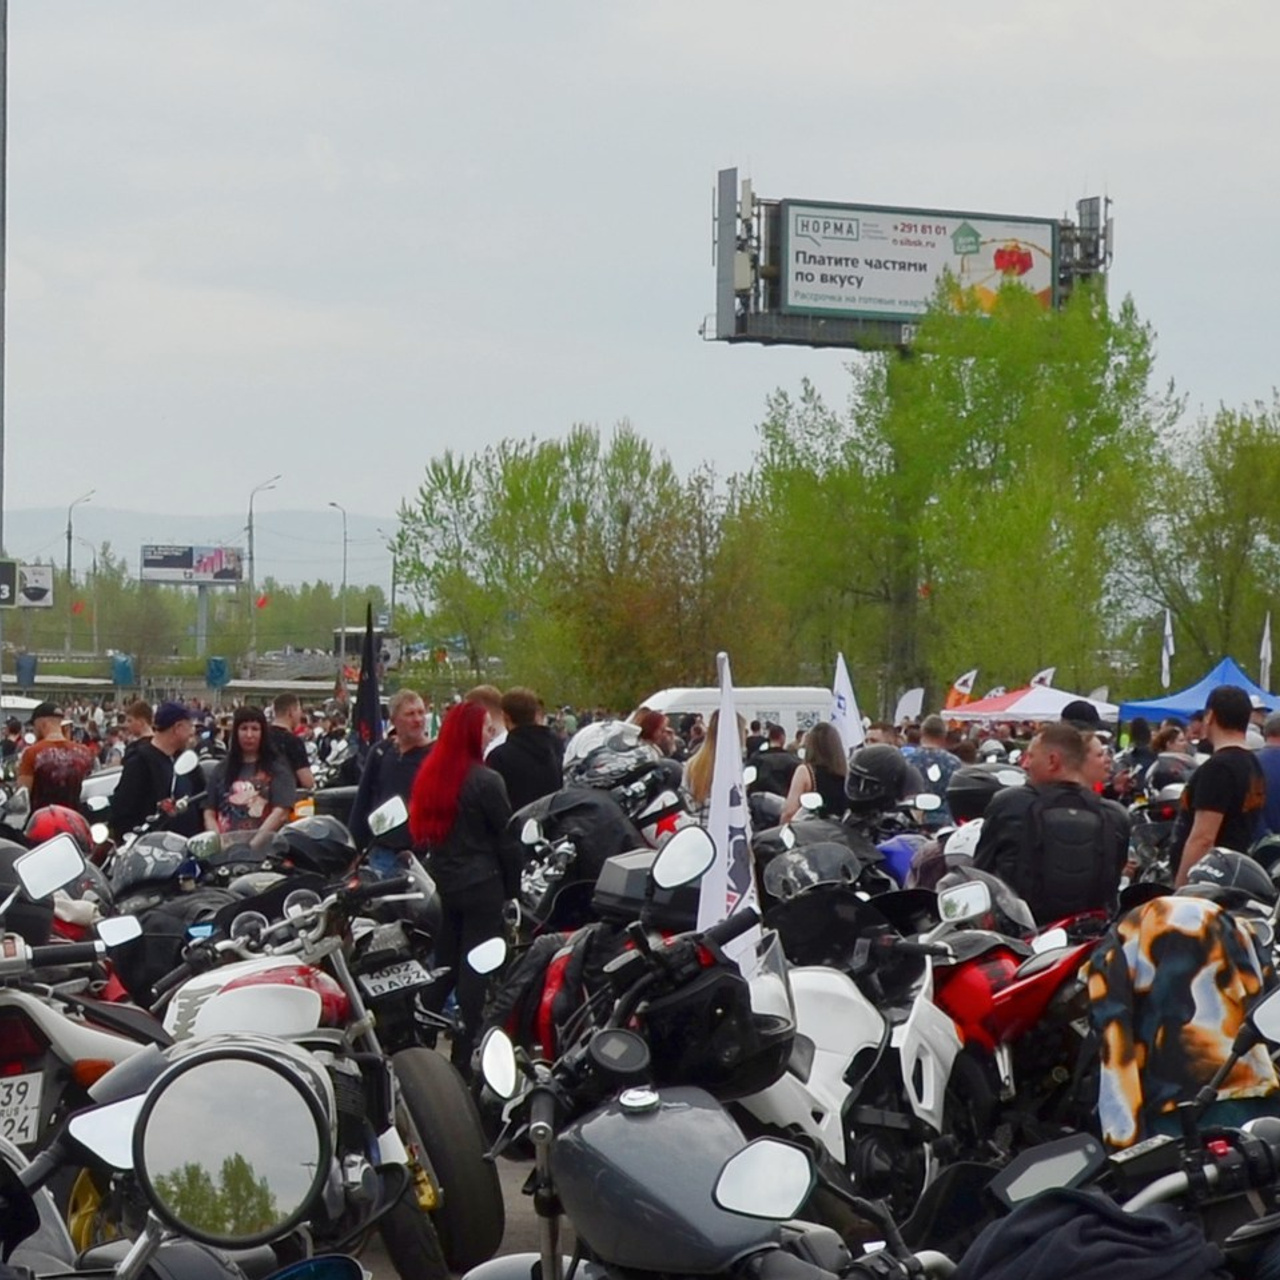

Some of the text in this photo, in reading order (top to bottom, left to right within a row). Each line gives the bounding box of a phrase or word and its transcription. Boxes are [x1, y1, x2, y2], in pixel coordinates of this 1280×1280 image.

[800, 219, 855, 236] НОРМА
[795, 250, 928, 273] Платите частями
[795, 271, 864, 289] по вкусу
[0, 1106, 20, 1118] RUS
[3, 1115, 30, 1141] 24
